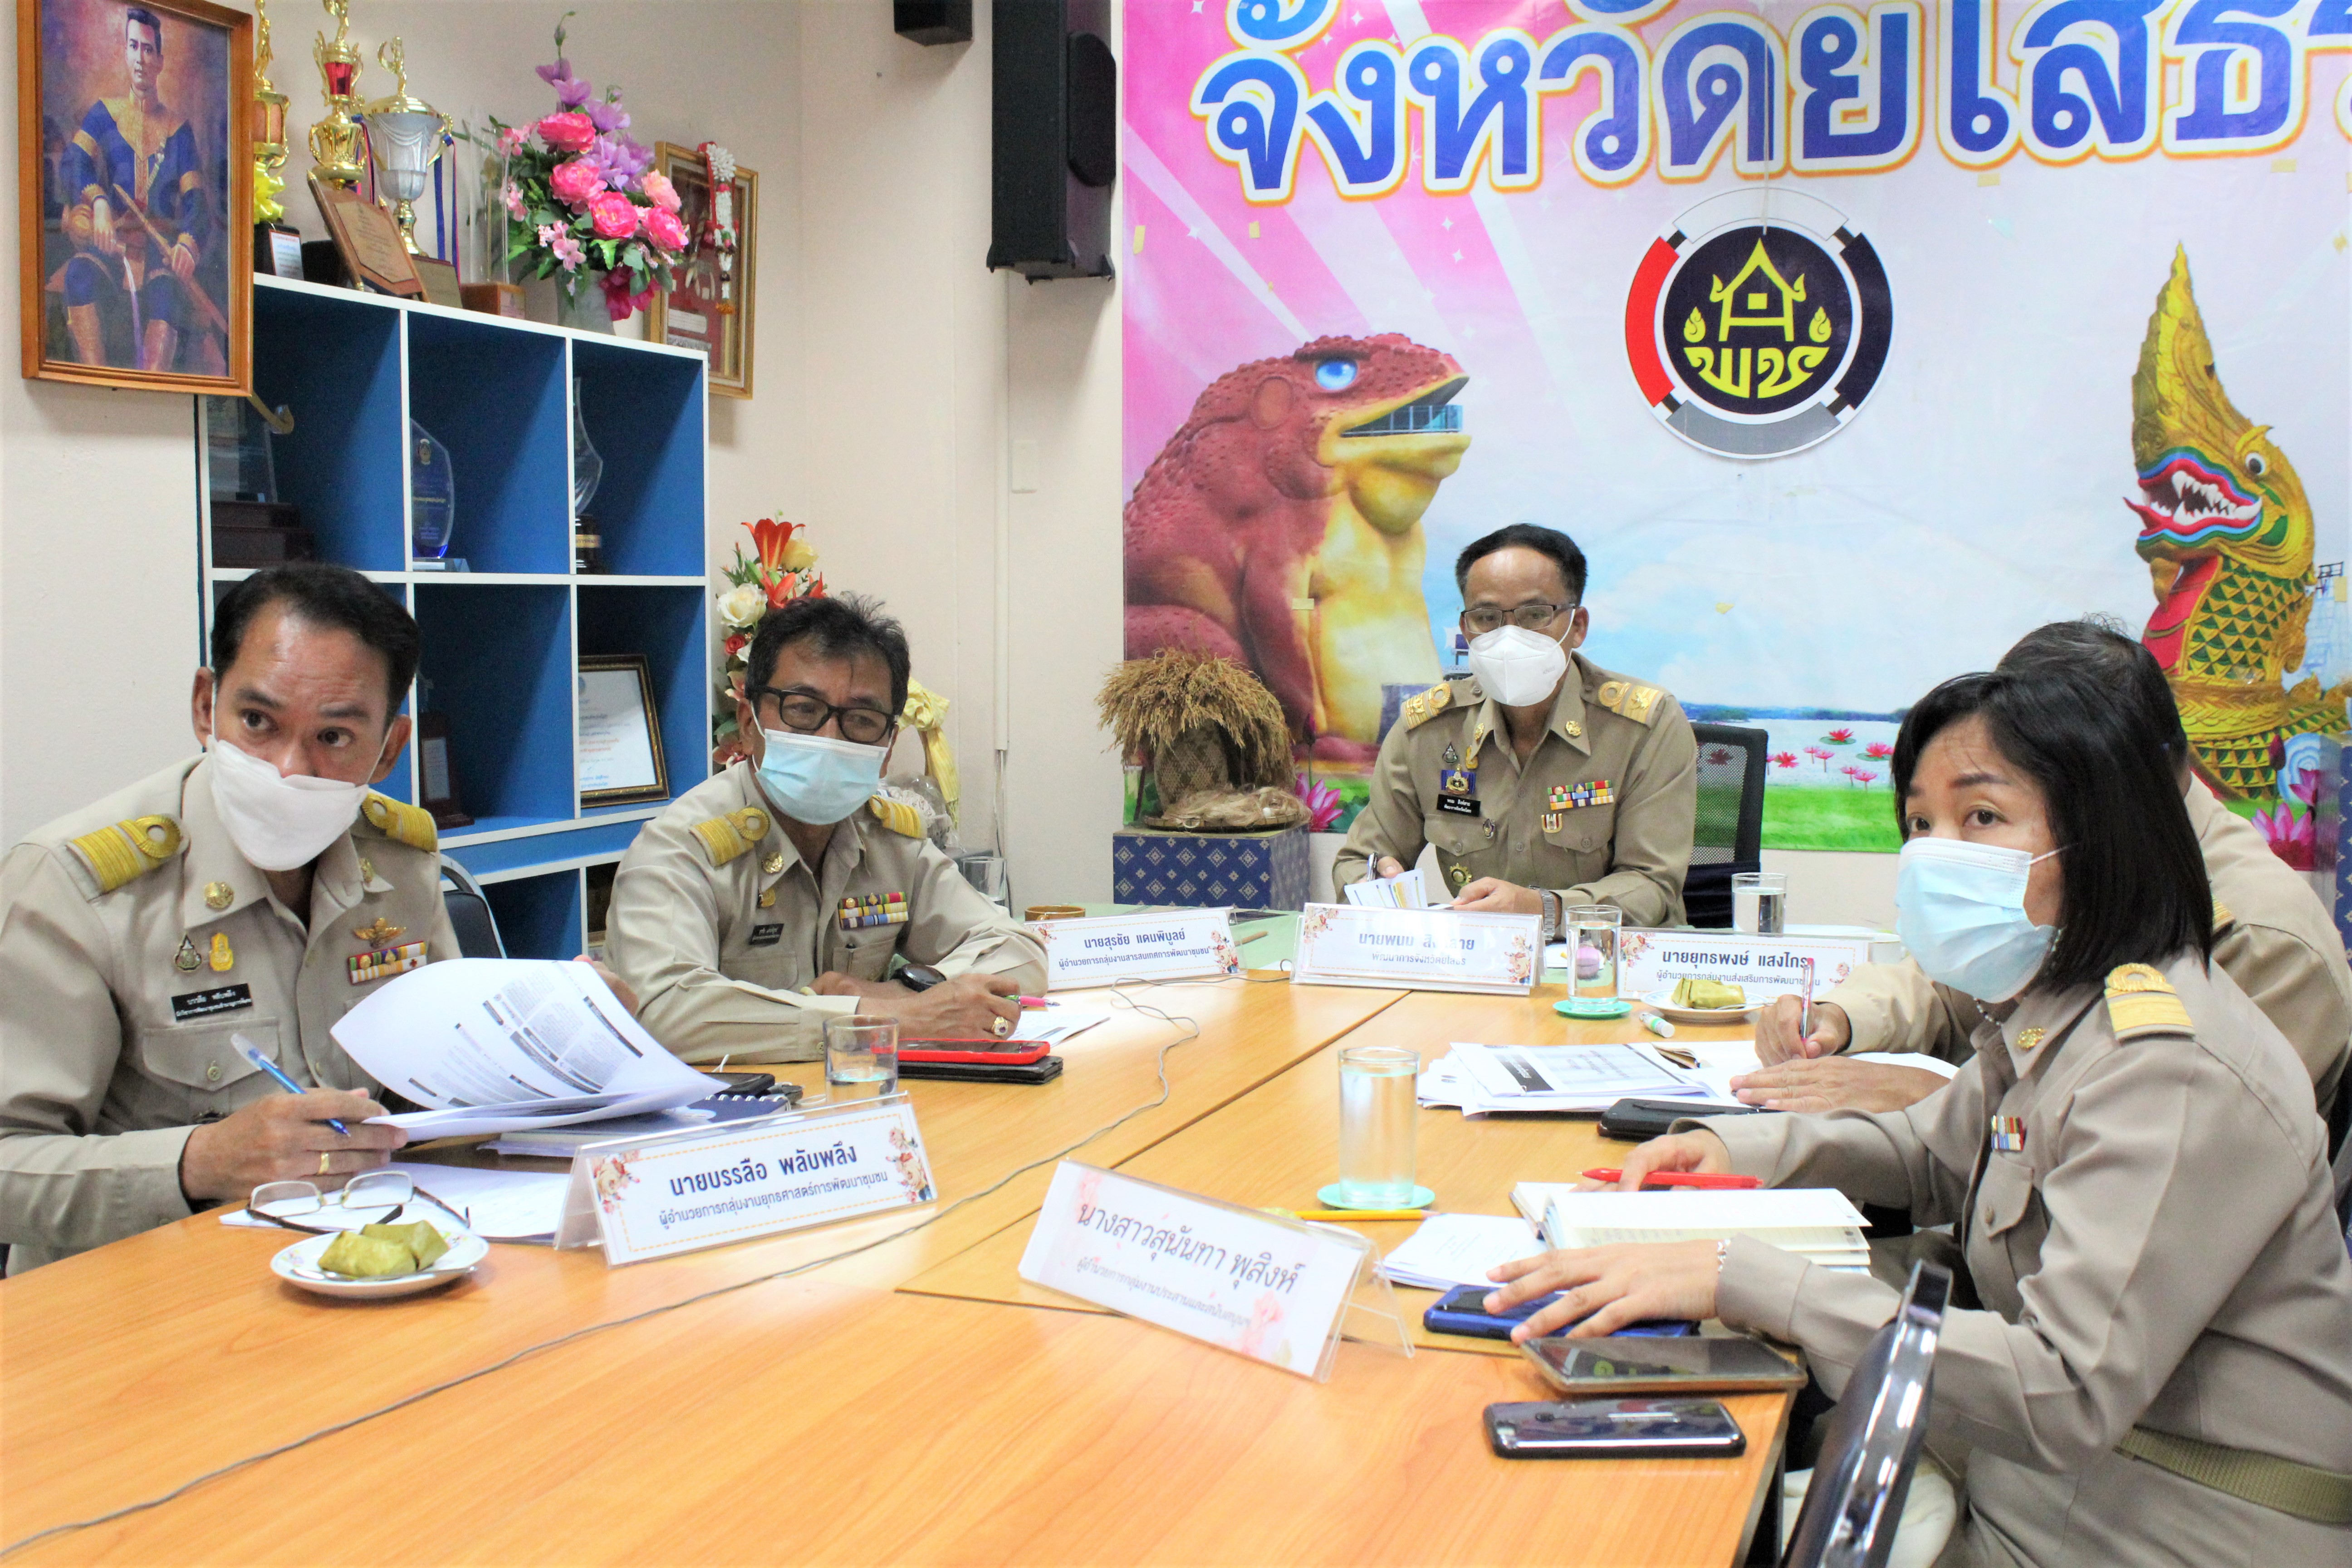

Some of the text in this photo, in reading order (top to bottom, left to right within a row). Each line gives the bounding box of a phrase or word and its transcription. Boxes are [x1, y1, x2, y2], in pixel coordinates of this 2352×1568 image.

[1084, 927, 1186, 951] นายสุรชัย แดนพิบูลย์
[1358, 933, 1415, 947] นายพนม
[1058, 947, 1210, 970] ผู้อำนวยการกลุ่มงานสารสนเทศการพัฒนาชุมชน
[1662, 950, 1808, 969] นายยุทธพงษ์ แสงไกร
[669, 1140, 858, 1196] นายบรรลือ พลับพลึง
[659, 1170, 888, 1230] ผู้อำนวยการกลุ่มงานยุทธศาสตร์การพัฒนาชุมชน
[1077, 1203, 1306, 1294] นางสาวสุนันทา พุสิงห์
